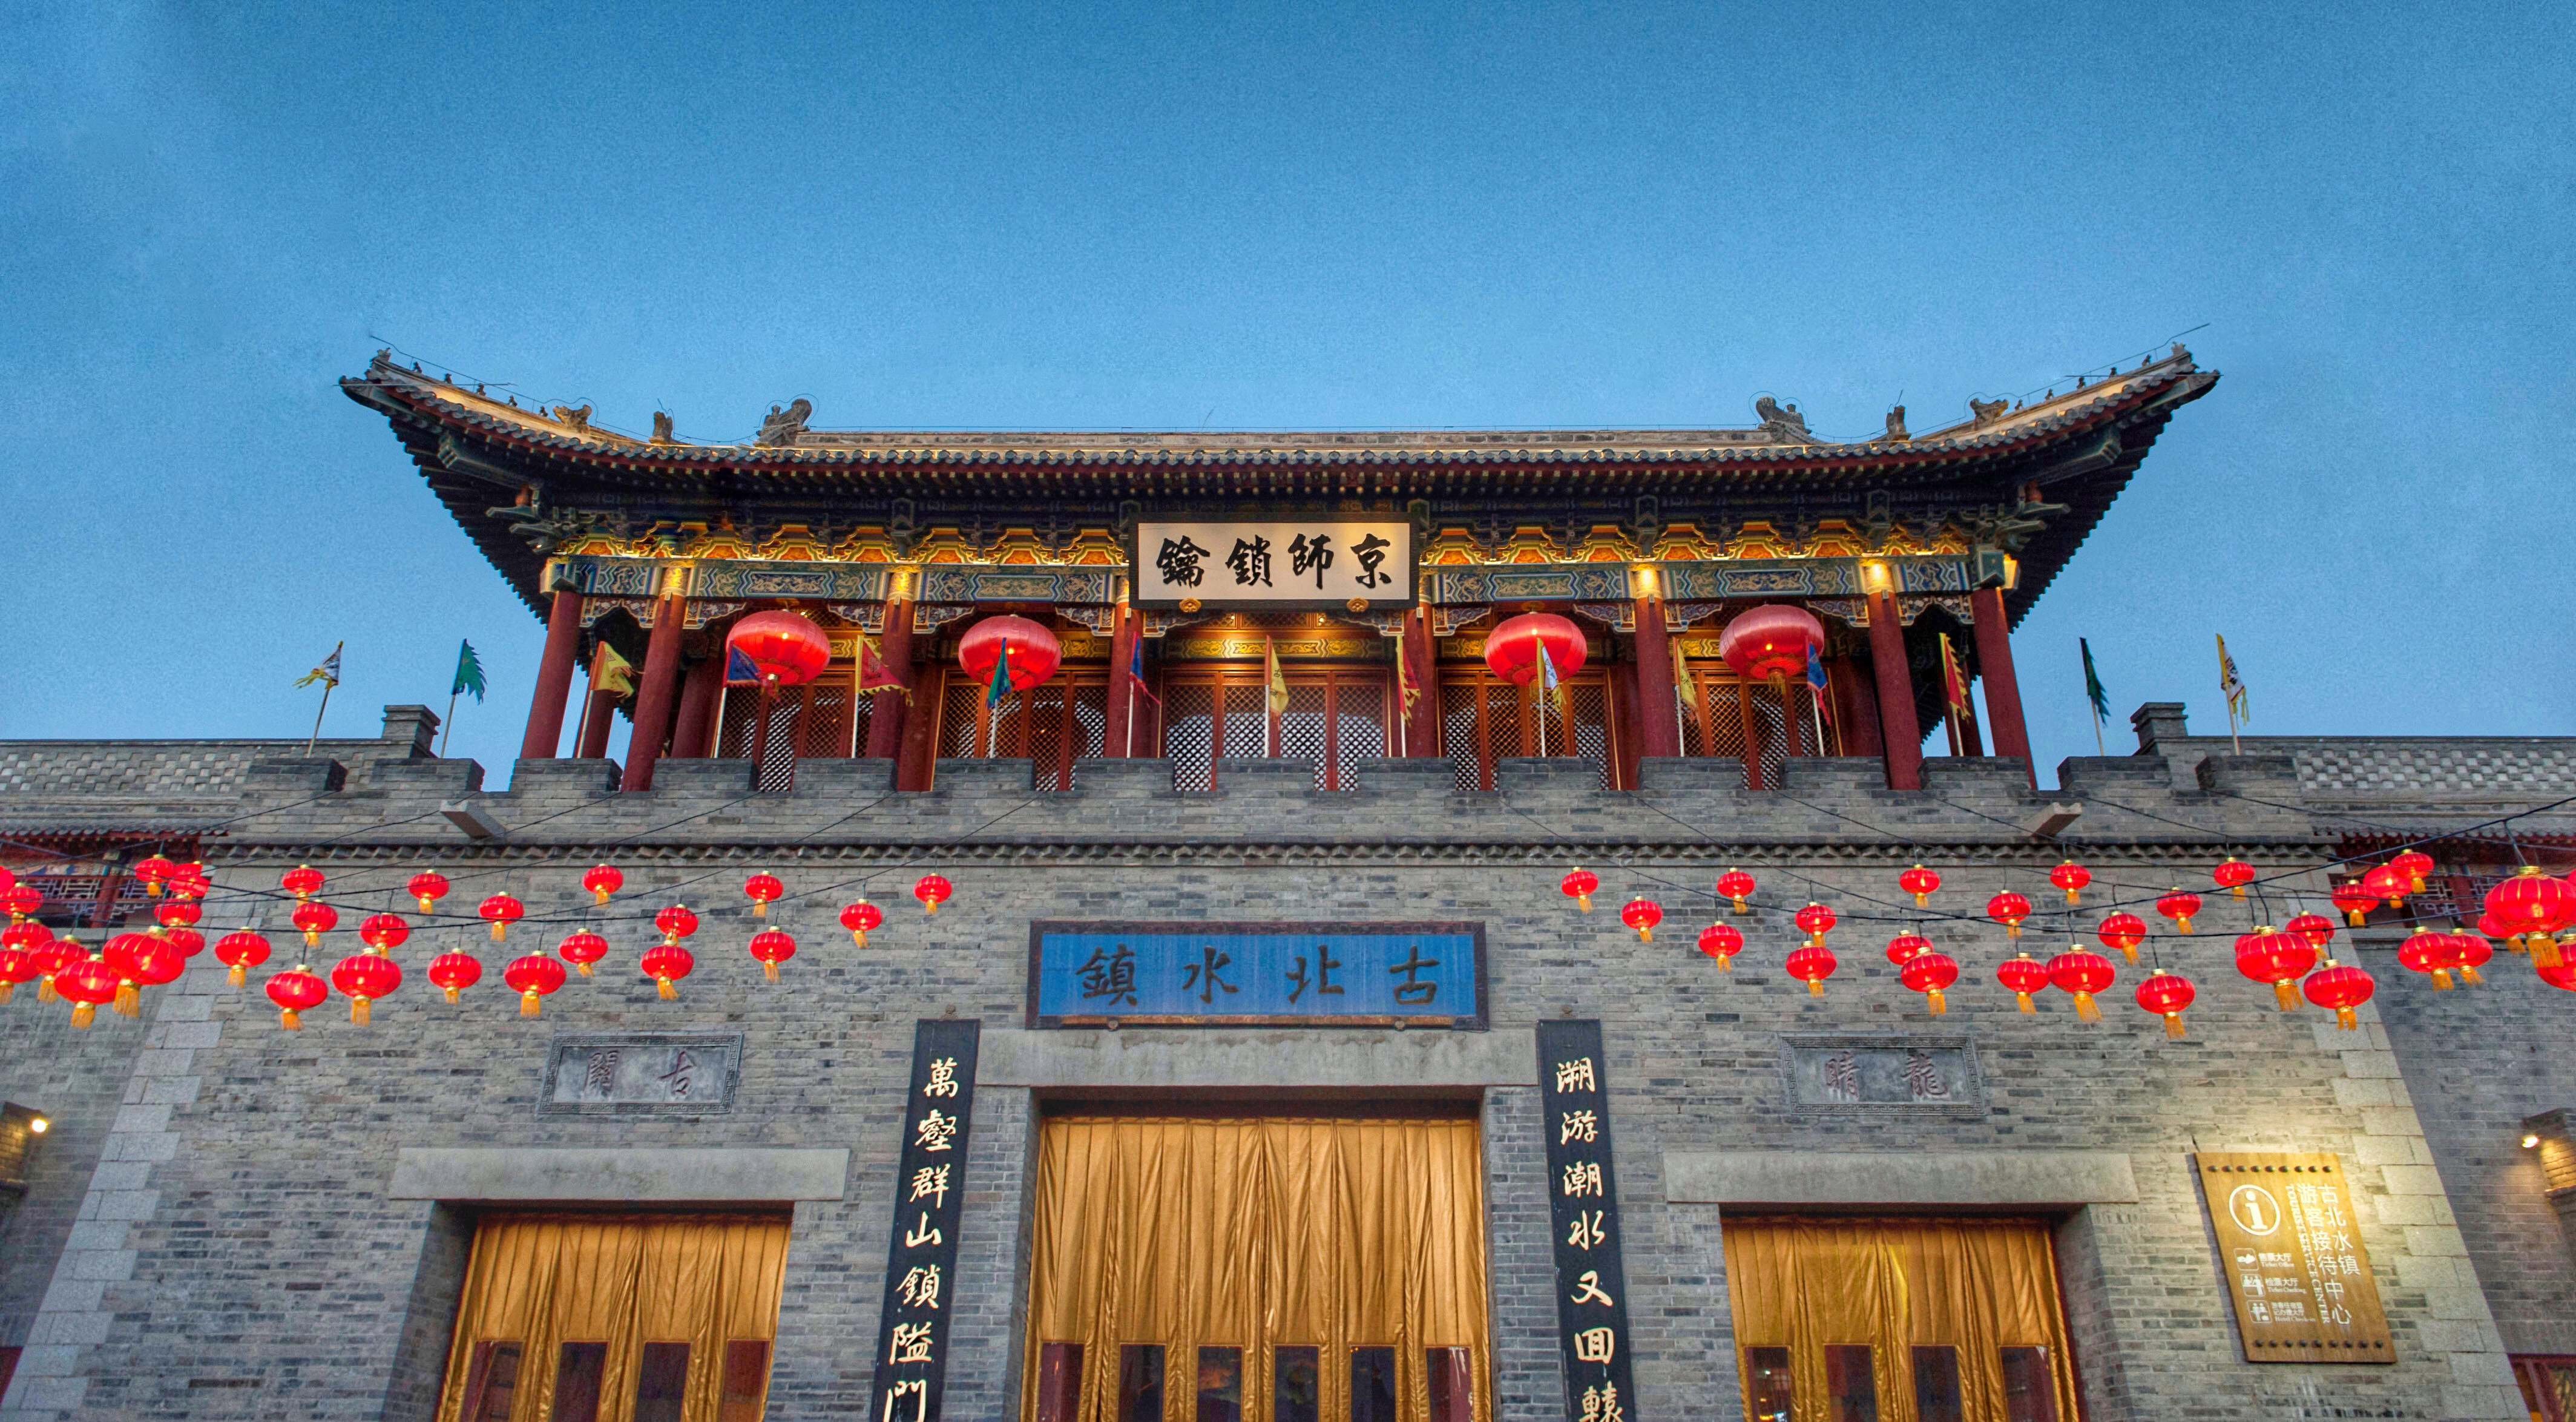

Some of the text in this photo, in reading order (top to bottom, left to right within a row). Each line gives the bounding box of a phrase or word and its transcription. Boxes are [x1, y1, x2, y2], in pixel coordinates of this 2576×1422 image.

[1076, 943, 1440, 1007] 古北水鎮
[2285, 1183, 2307, 1233] TOURIST
[2312, 1279, 2330, 1324] CENTER
[2296, 1183, 2352, 1325] 游客接待中心
[2316, 1183, 2361, 1276] 古北水镇
